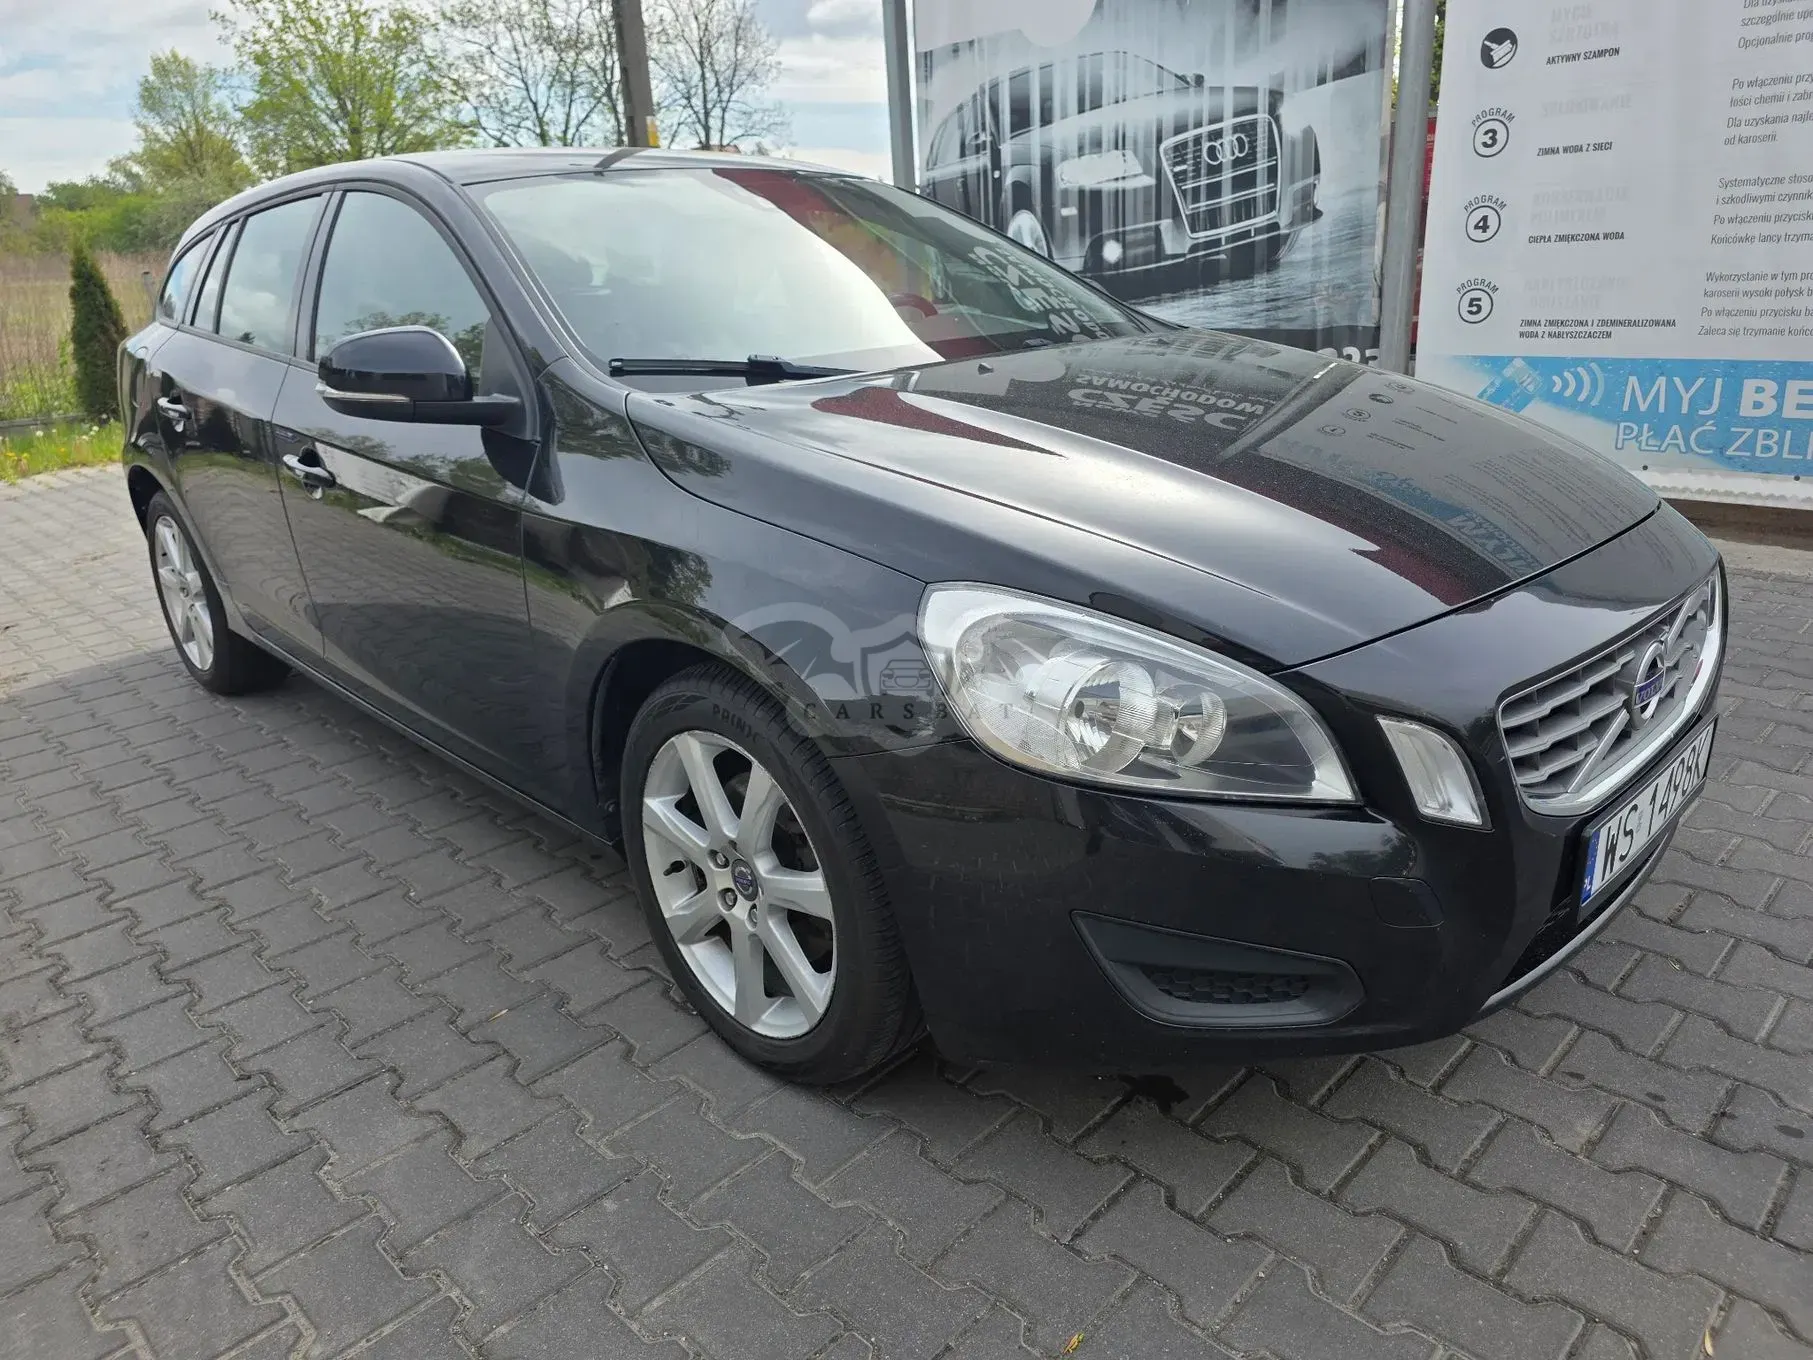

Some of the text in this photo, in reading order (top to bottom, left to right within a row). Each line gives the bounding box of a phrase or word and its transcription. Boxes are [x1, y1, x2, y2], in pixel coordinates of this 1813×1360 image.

[1738, 32, 1793, 49] Opcjonalnie
[1546, 47, 1621, 65] AKTYWNY SZAMPON
[1732, 78, 1744, 90] Po
[1746, 75, 1793, 89] włączeniu
[1754, 92, 1784, 105] chemii
[1472, 107, 1515, 127] PROGRAM
[1727, 116, 1742, 128] Dla
[1744, 114, 1789, 128] uzyskania
[1481, 128, 1498, 148] 3
[1724, 134, 1736, 146] od
[1537, 141, 1613, 157] ZIMNA WODA Z SIECI
[1718, 175, 1786, 190] Systematyczne
[1463, 195, 1507, 213] PROGRAM
[1721, 192, 1776, 205] szkodliwymi
[1473, 214, 1490, 233] 4
[1713, 214, 1725, 225] Po
[1727, 212, 1772, 226] włączeniu
[1528, 231, 1625, 245] CIEPŁA ZMIĘKCZONA WODA
[1758, 232, 1782, 244] lancy
[1705, 271, 1768, 283] Wykorzystanie
[1780, 271, 1798, 283] tym
[1456, 278, 1499, 295] PROGRAM
[1742, 287, 1773, 299] wysoki
[1774, 287, 1804, 299] połysk
[1466, 297, 1483, 315] 5
[1700, 306, 1713, 317] Po
[1714, 307, 1757, 318] włączeniu
[1759, 306, 1802, 319] przycisku
[1520, 319, 1542, 328] ZIMNA
[1543, 319, 1589, 329] ZMIĘKCZONA
[1596, 319, 1676, 328] ZDEMINERALIZOWANA
[1698, 325, 1726, 336] Zaleca
[1728, 326, 1740, 338] się
[1742, 326, 1786, 338] trzymanie
[1519, 331, 1612, 339] WODA Z NABŁYSZCZACZEM
[1622, 376, 1813, 419] MYJ BE
[1616, 419, 1716, 454] PŁAĆ
[1600, 803, 1638, 882] WS
